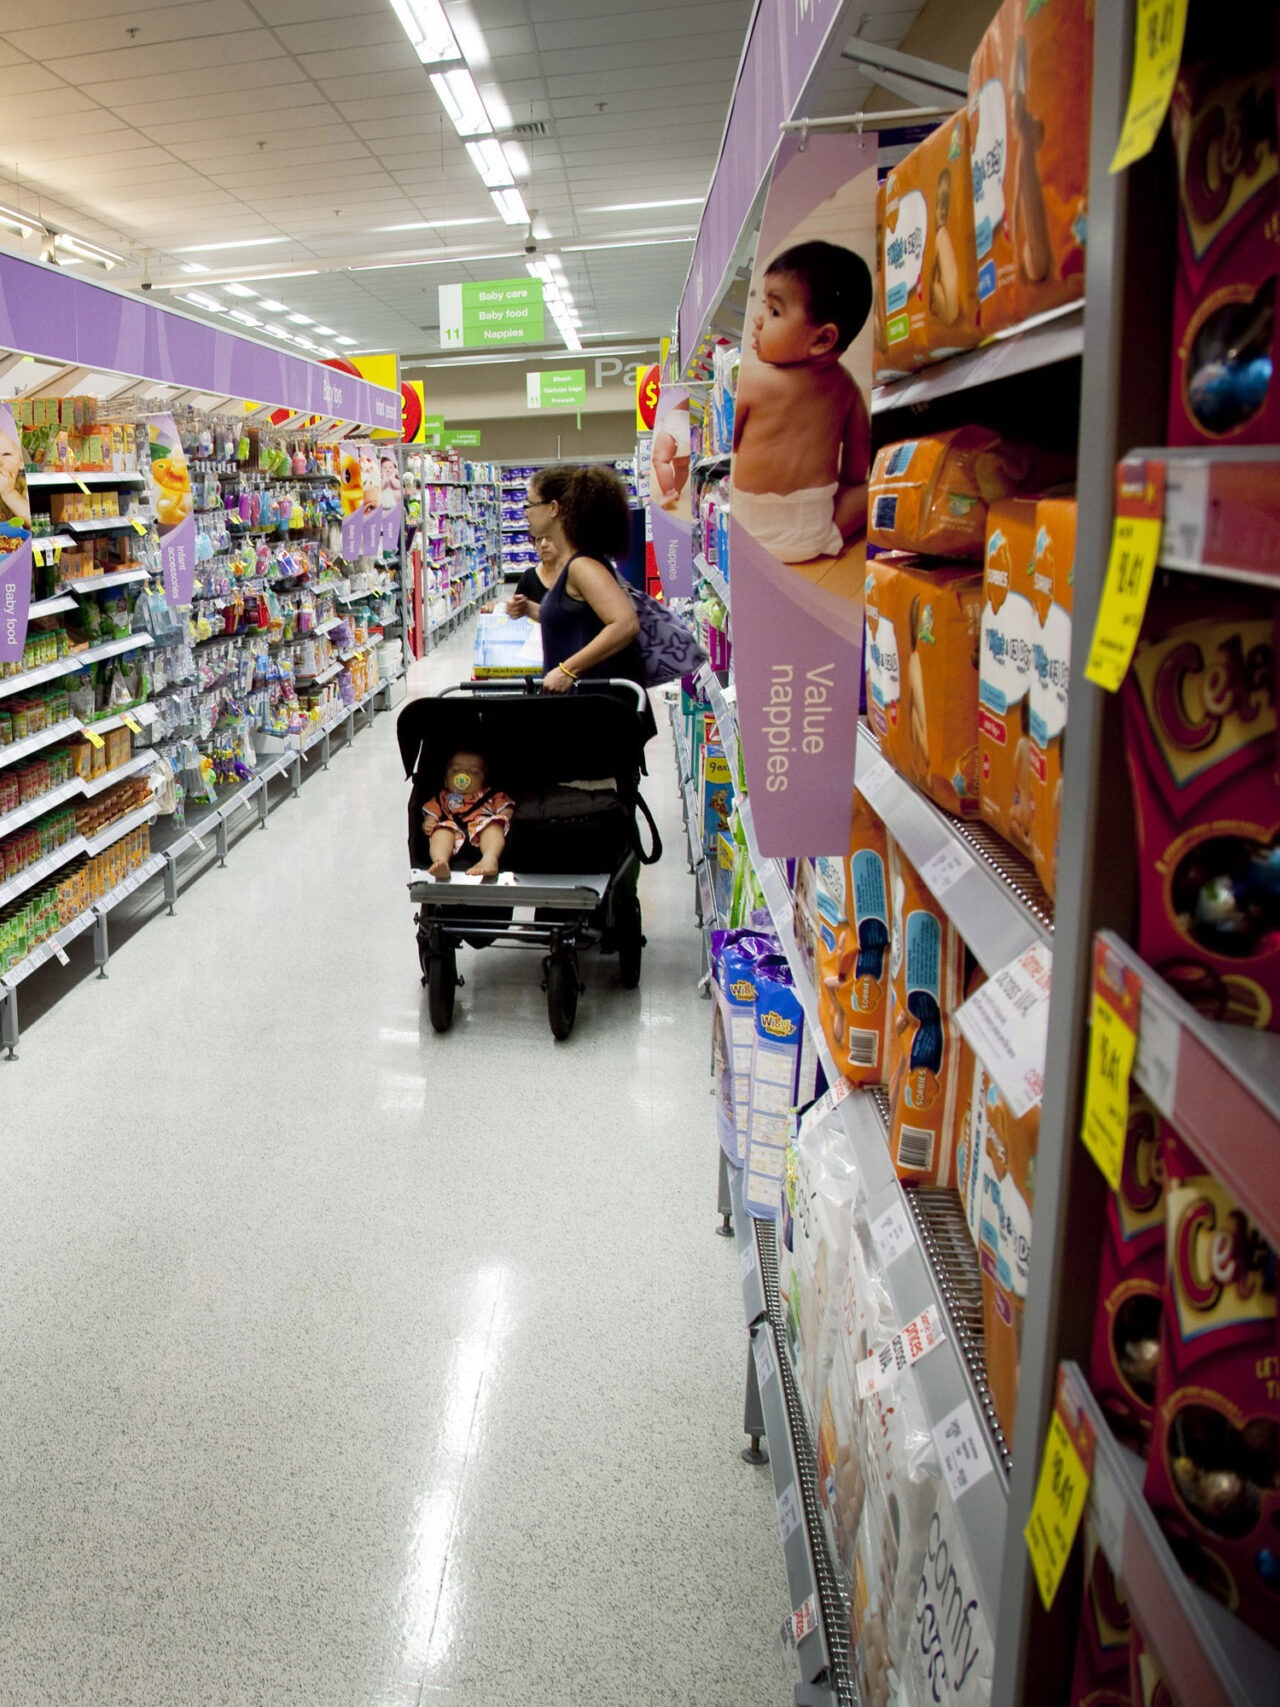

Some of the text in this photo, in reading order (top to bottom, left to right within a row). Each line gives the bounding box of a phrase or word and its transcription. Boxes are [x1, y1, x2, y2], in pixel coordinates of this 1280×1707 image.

[479, 289, 528, 302] Baby care
[479, 308, 529, 321] Baby food
[445, 328, 460, 341] 11
[484, 328, 524, 340] Nappies
[168, 546, 179, 599] accessories
[177, 545, 186, 570] Infant
[668, 539, 679, 581] Nappies
[5, 583, 18, 645] Baby food
[802, 663, 835, 754] Value
[761, 664, 796, 793] nappies
[861, 977, 871, 1010] SORBIES
[914, 1069, 927, 1106] SORBIES
[891, 1335, 908, 1372] across
[903, 1321, 924, 1358] prices
[878, 1346, 890, 1375] WA.
